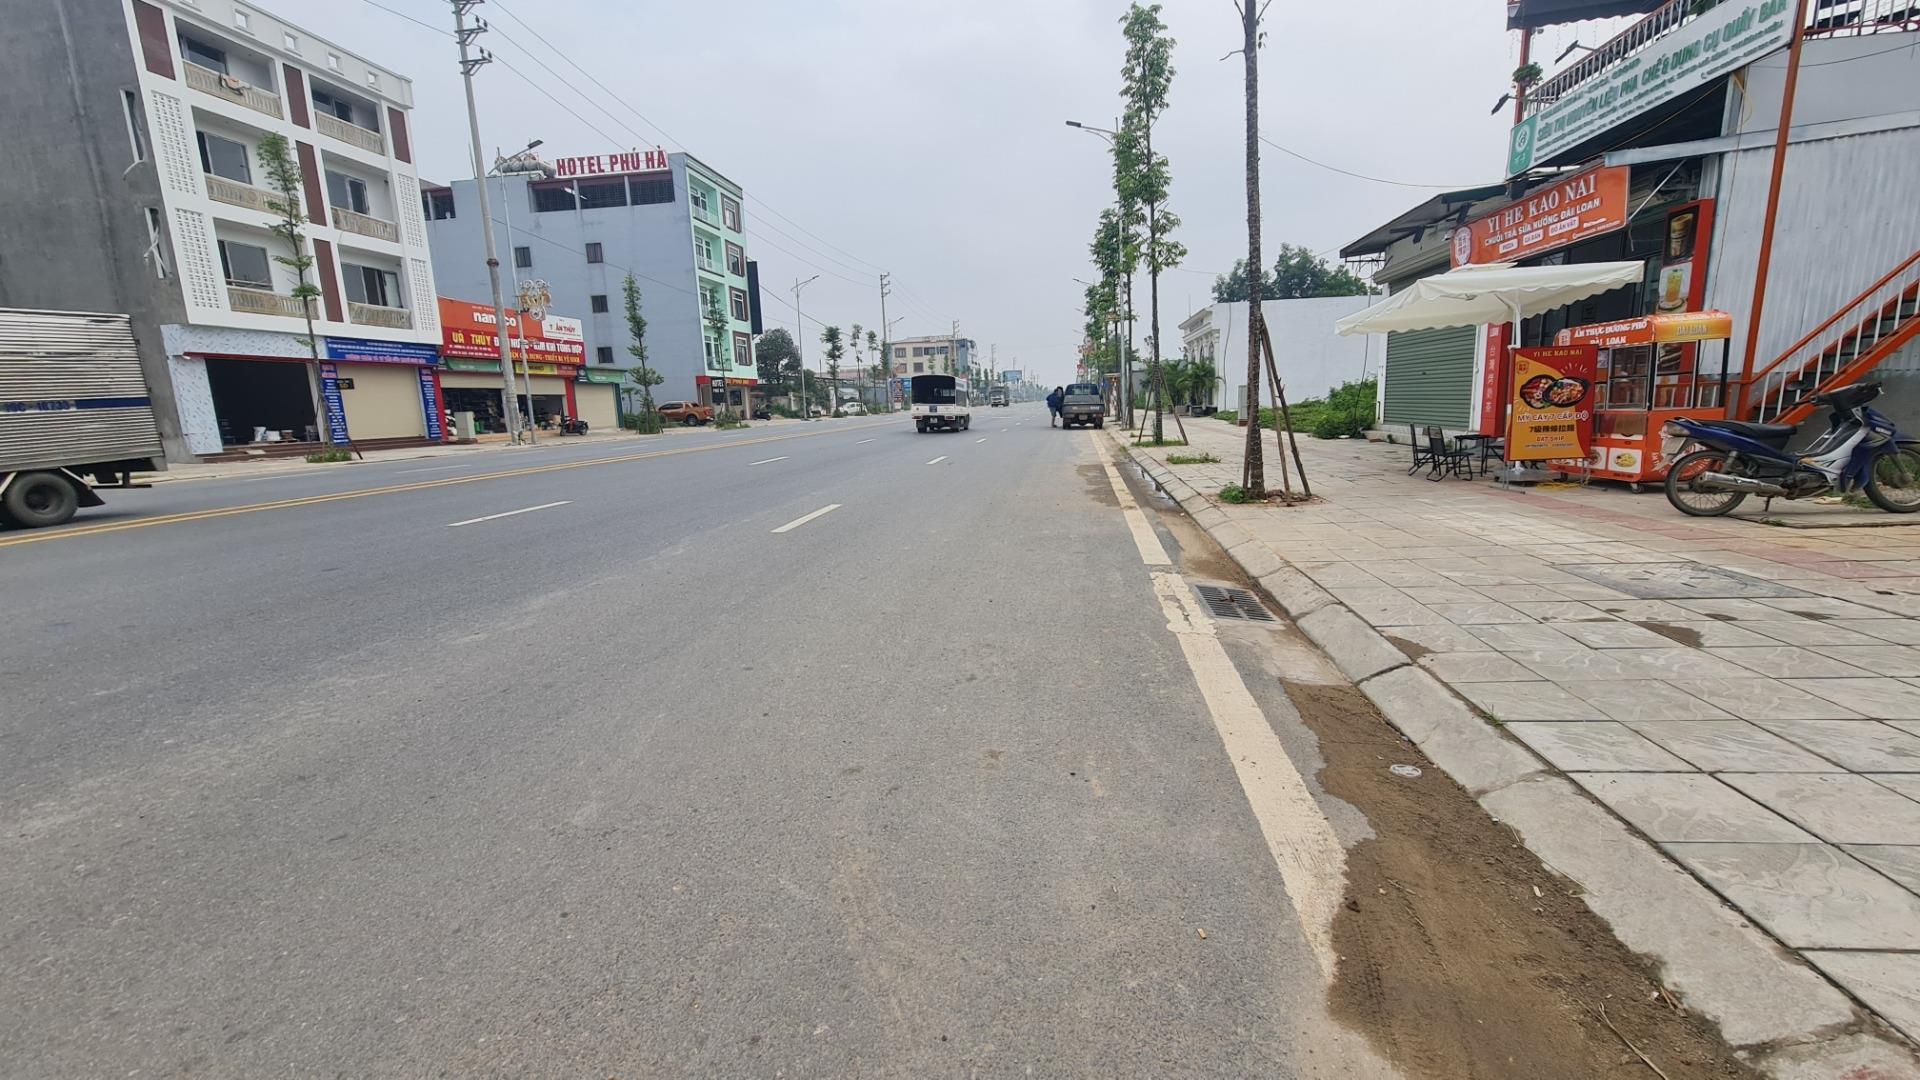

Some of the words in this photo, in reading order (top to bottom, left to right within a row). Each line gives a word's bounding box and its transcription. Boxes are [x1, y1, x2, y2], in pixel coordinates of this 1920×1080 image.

[1620, 74, 1638, 97] PHA
[1703, 28, 1721, 52] CỤ
[556, 156, 605, 176] HOTEL
[1488, 215, 1500, 233] YI
[1504, 207, 1524, 228] HE
[1529, 191, 1560, 217] KAO
[1565, 174, 1597, 203] NAI
[1577, 198, 1601, 214] LOAN
[473, 311, 517, 327] nanco
